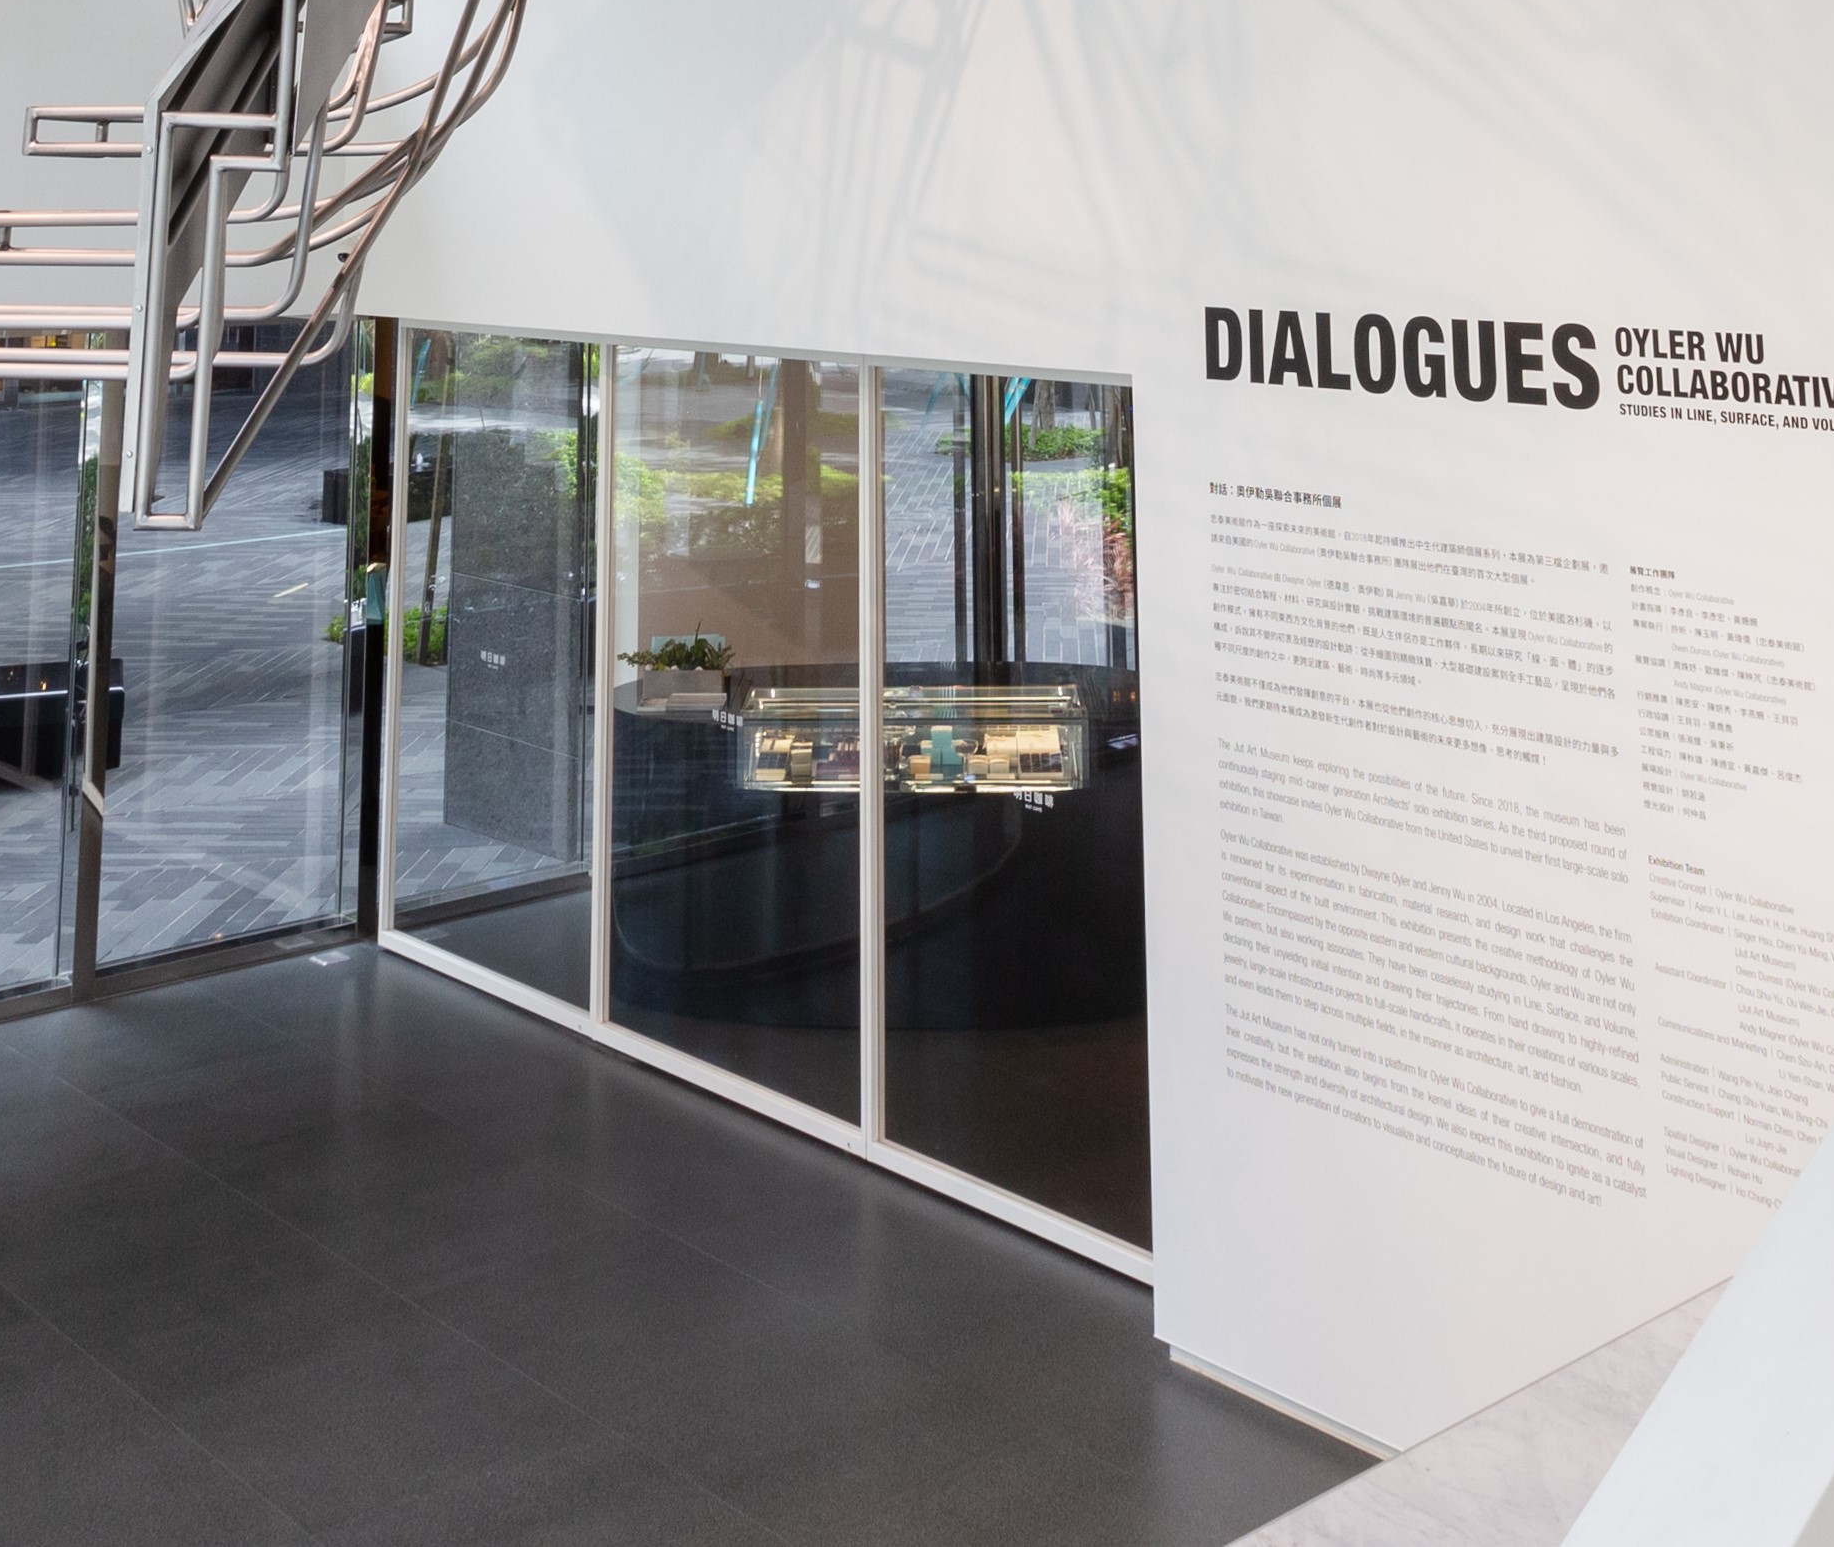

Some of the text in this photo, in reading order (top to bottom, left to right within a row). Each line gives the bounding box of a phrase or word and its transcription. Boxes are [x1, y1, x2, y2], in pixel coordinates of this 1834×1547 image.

[1205, 307, 1599, 409] DIALOGUES
[1616, 327, 1764, 364] OYLER WU
[1620, 404, 1667, 419] STUDIES
[1671, 408, 1682, 419] IN
[1687, 409, 1717, 424] LINE,
[1721, 411, 1779, 429] SURFACE,
[1783, 416, 1808, 429] AND
[1218, 737, 1626, 838] The Jut Art Museum keeps exploring the possibilities of the future. Since 2018, the museum has been
[1218, 759, 1627, 861] continuously staging mid-career generation Architects' solo exhibition series. As the third proposed round of
[1219, 799, 1283, 823] exhibition in Taiwan.
[1219, 779, 1629, 884] exhibition, this showcase invites Oyler Wu Collaborative from the United States to unveil their first large-scale solo
[1220, 828, 1632, 944] Oyler Wu Collaborative was established by Dwayne Oyler and Jenny Wu in 2004. Located in Los Angeles, the firm
[1647, 854, 1705, 876] Exhibition Team
[1649, 872, 1795, 915] Creative Concept Oyler Wu Collaborative
[1221, 871, 1635, 992] conventional aspect of the built environment. This exhibition presents the creative methodology of Oyler Wu
[1227, 1066, 1602, 1208] to motivate the new generation of creators to visualize and conceptualize the future of design and art!
[1717, 1068, 1739, 1087] Wang
[1739, 1075, 1765, 1094] Pei-Yu,
[1766, 1083, 1783, 1099] Jojo
[1784, 1088, 1809, 1108] Chang
